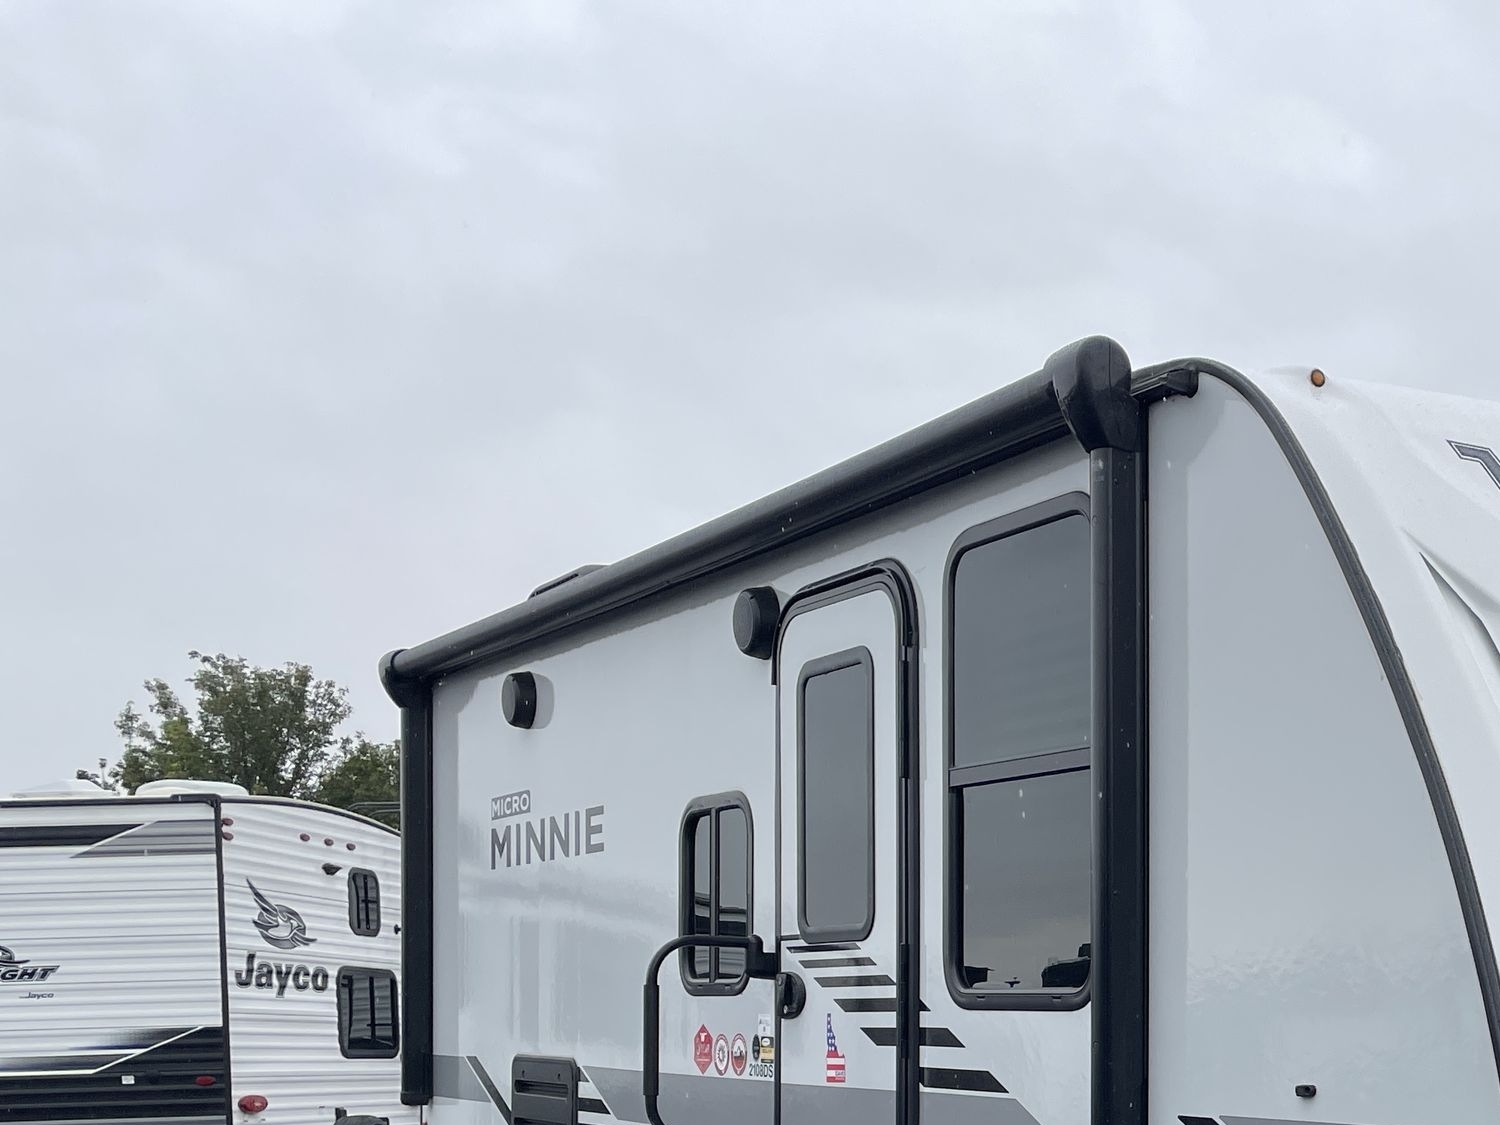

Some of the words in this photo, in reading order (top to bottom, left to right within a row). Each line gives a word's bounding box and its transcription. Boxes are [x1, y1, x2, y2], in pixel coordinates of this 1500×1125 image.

[491, 793, 530, 818] MICRO
[490, 804, 605, 871] MINNIE
[0, 965, 60, 983] GHT
[234, 951, 329, 998] Jayco
[19, 991, 55, 1000] Jayco
